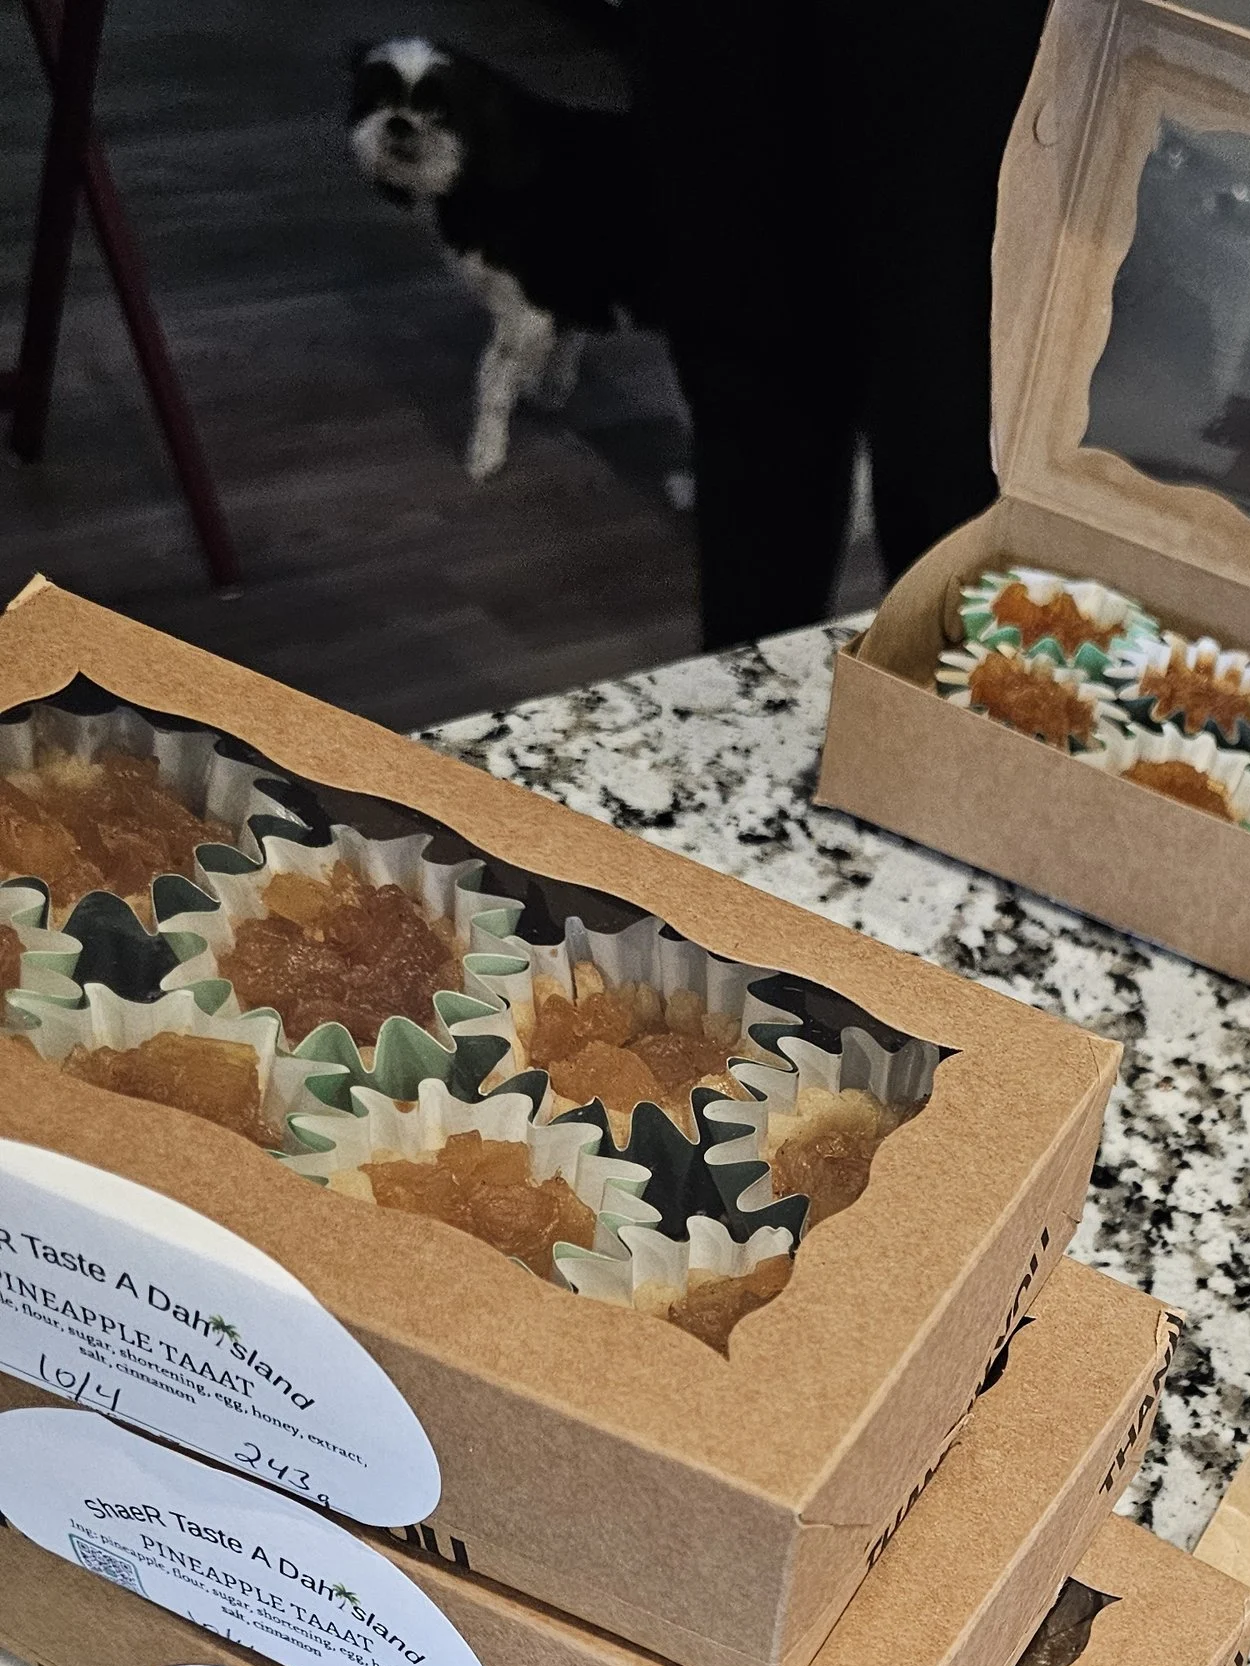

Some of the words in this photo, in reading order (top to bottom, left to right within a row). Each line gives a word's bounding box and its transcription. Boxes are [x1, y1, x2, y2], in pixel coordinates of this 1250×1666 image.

[0, 1270, 153, 1353] INEAPPLE
[159, 1340, 255, 1399] TAAAT
[21, 1233, 106, 1282] Taste
[115, 1272, 139, 1298] A
[148, 1285, 211, 1337] Dah
[22, 1303, 64, 1332] flour,
[68, 1326, 116, 1355] sugar,
[120, 1348, 212, 1399] shortening,
[214, 1391, 249, 1414] egg,
[252, 1405, 304, 1439] honey,
[307, 1433, 368, 1468] extract,
[39, 1353, 121, 1411] 10/4
[79, 1346, 113, 1369] salt,
[116, 1363, 197, 1404] cinnamon
[100, 1534, 170, 1575] pineapple,
[172, 1568, 210, 1593] flour,
[212, 1587, 253, 1613] sugar,
[256, 1608, 336, 1652] shortening,
[339, 1647, 369, 1666] egg,
[140, 1534, 285, 1612] PINEAPPLE
[290, 1603, 375, 1653] TAAAT
[169, 1511, 243, 1554] Taste
[251, 1546, 272, 1568] A
[279, 1557, 335, 1601] Dah
[221, 1606, 250, 1626] salt,
[253, 1619, 323, 1657] cinnamon
